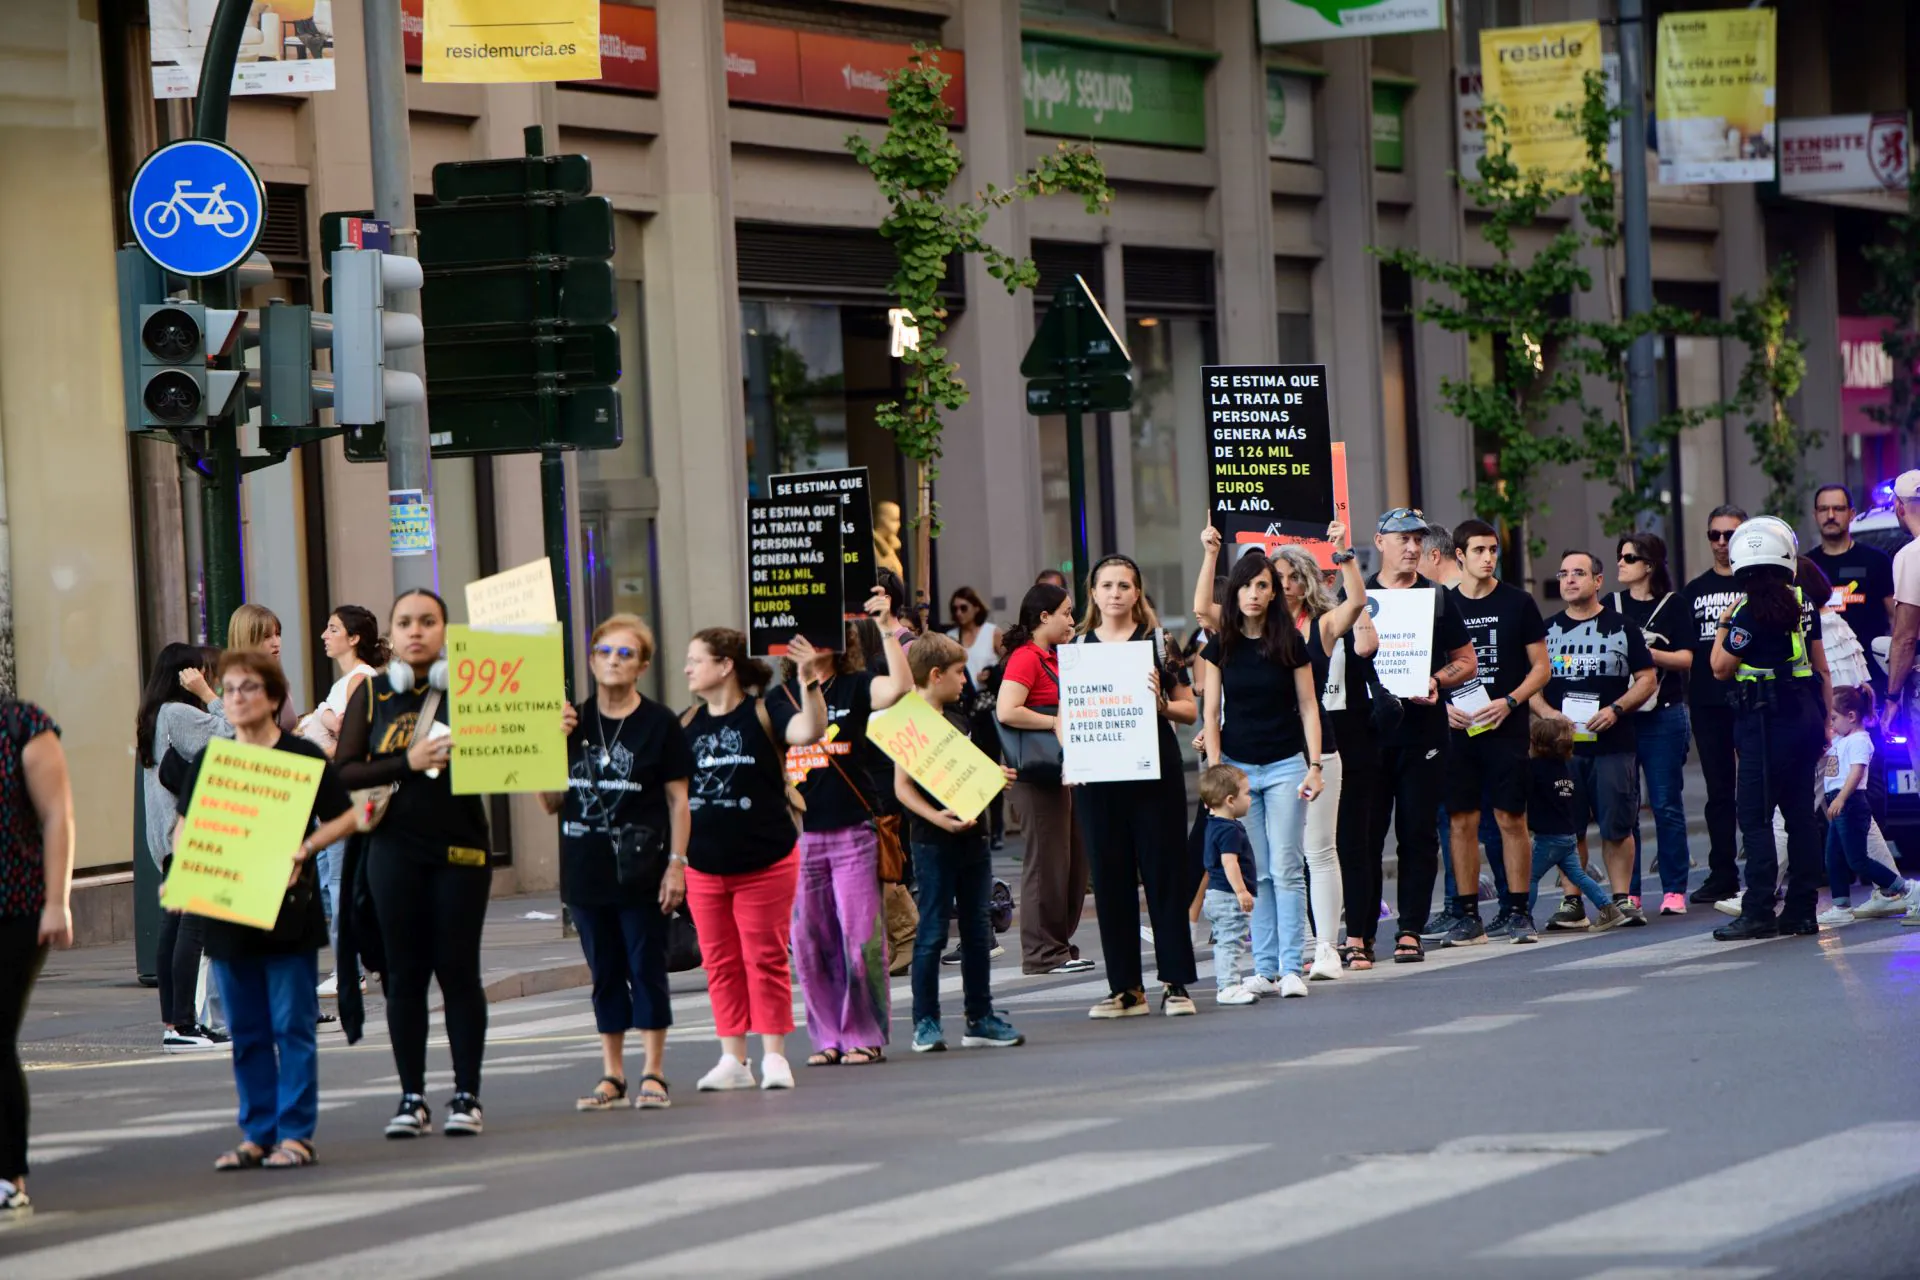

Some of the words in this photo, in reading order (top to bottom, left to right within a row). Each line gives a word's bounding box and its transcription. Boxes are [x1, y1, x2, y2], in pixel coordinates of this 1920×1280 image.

[446, 41, 577, 58] residemurcia.es
[1499, 36, 1583, 64] reside
[1075, 69, 1134, 124] seguros
[1210, 375, 1228, 388] SE
[1232, 375, 1286, 388] ESTIMA
[1291, 375, 1320, 388] QUE
[1211, 393, 1231, 405] LA
[1234, 393, 1280, 405] TRATA
[1284, 392, 1303, 405] DE
[1213, 410, 1290, 423] PERSONAS
[1214, 428, 1272, 440] GENERA
[1275, 425, 1307, 440] MÁS
[1215, 446, 1234, 458] DE
[1238, 446, 1264, 458] 126
[1268, 446, 1294, 458] MIL
[1216, 463, 1288, 476] MILLONES
[1291, 463, 1311, 475] DE
[777, 484, 792, 496] SE
[794, 480, 838, 494] ESTIMA
[839, 477, 863, 490] QUE
[1216, 481, 1265, 494] EUROS
[1217, 499, 1236, 511] AL
[1239, 496, 1275, 511] AÑO.
[752, 507, 766, 520] SE
[769, 506, 811, 519] ESTIMA
[813, 504, 836, 517] QUE
[752, 523, 767, 535] LA
[770, 522, 803, 534] TRATA
[807, 521, 823, 533] DE
[841, 520, 855, 533] ÁS
[752, 537, 812, 550] PERSONAS
[752, 553, 798, 566] GENERA
[800, 550, 825, 564] MÁS
[844, 552, 859, 564] DE
[752, 570, 768, 582] DE
[771, 569, 791, 580] 126
[793, 568, 814, 579] MIL
[753, 584, 809, 597] MILLONES
[811, 583, 826, 595] DE
[753, 600, 791, 612] EUROS
[753, 616, 769, 628] AL
[771, 612, 799, 627] AÑO.
[1701, 621, 1717, 636] LIB
[456, 656, 524, 697] 99%
[1067, 685, 1078, 694] YO
[1080, 684, 1114, 694] CAMINO
[458, 703, 472, 714] DE
[478, 702, 501, 714] LAS
[504, 700, 562, 712] VÍCTIMAS
[1068, 697, 1085, 706] POR
[1101, 707, 1143, 717] OBLIGADO
[500, 723, 526, 734] SON
[1070, 721, 1076, 731] A
[1078, 721, 1103, 731] PEDIR
[1105, 719, 1136, 729] DINERO
[888, 717, 930, 768] 99%
[1070, 734, 1081, 743] EN
[1083, 733, 1094, 743] LA
[1096, 732, 1125, 742] CALLE.
[460, 744, 544, 757] RESCATADAS.
[213, 754, 291, 779] ABOLIENDO
[294, 771, 312, 784] LA
[207, 774, 291, 802] ESCLAVITUD
[193, 817, 240, 836] LUGAR
[242, 827, 253, 839] Y
[187, 838, 224, 855] PARA
